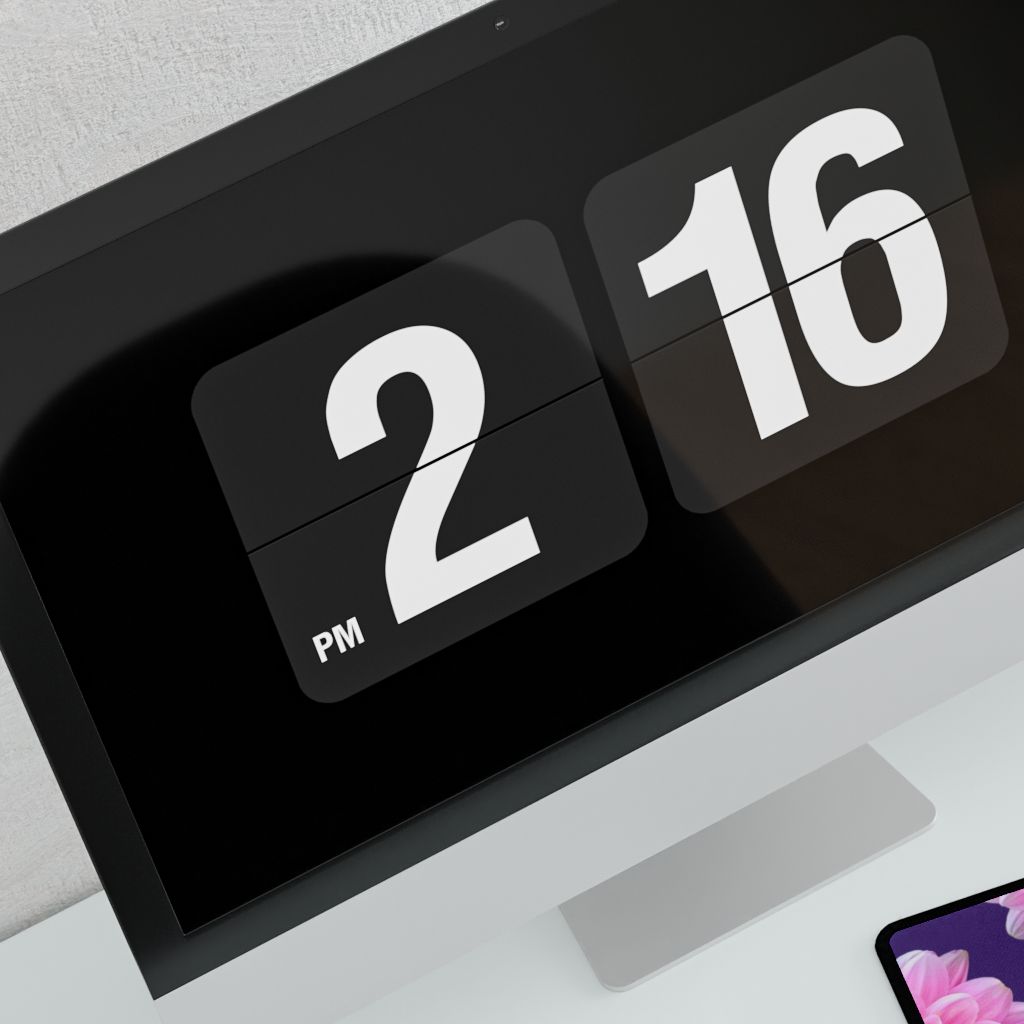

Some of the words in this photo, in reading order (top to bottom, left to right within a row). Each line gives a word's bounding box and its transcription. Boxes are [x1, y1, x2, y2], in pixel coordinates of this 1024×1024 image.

[326, 326, 540, 630] 2
[638, 108, 947, 439] 16
[313, 617, 364, 663] PM
